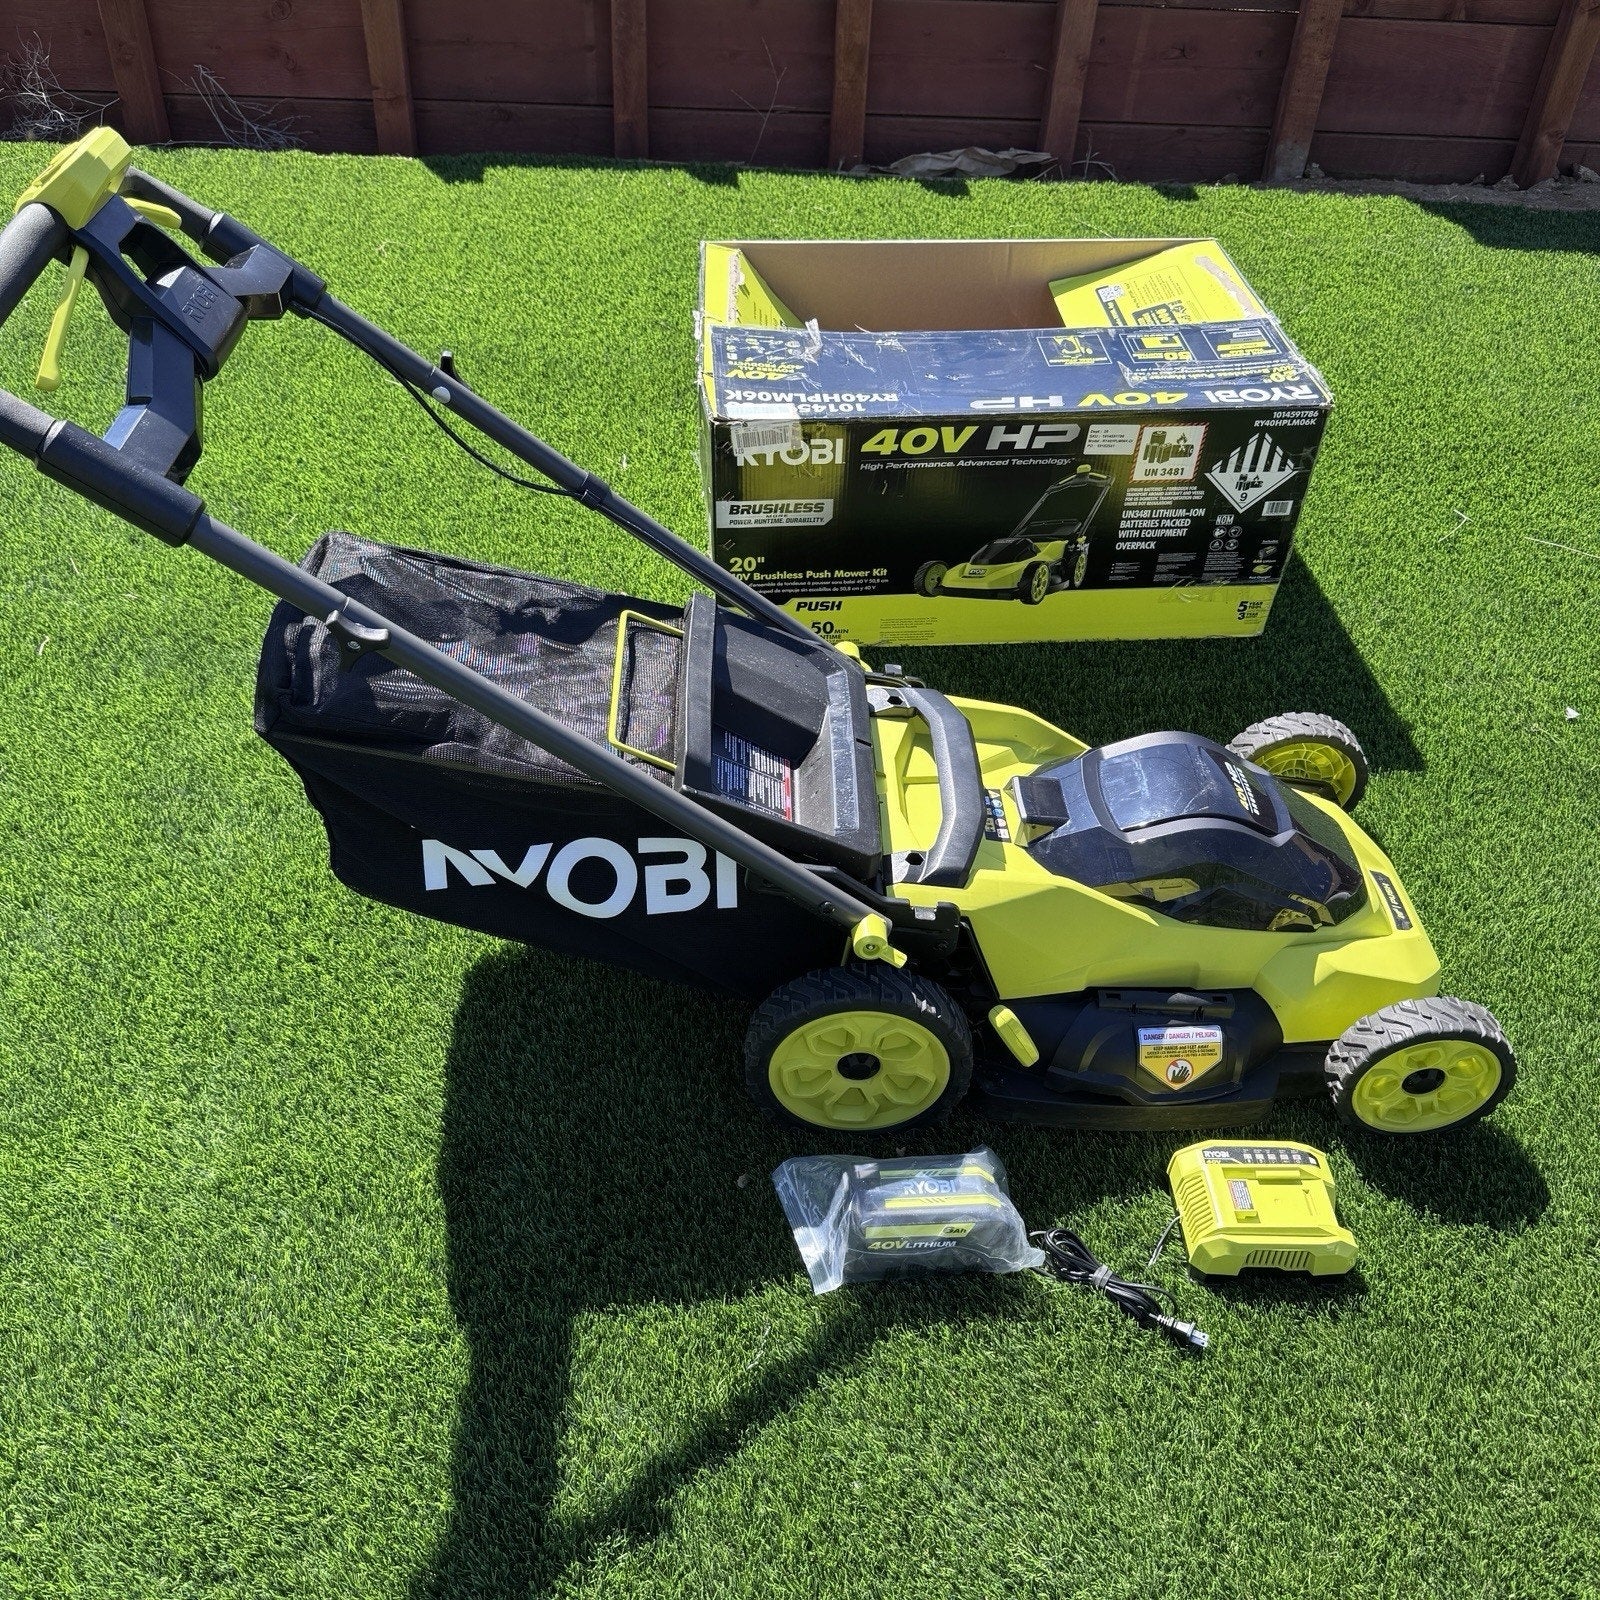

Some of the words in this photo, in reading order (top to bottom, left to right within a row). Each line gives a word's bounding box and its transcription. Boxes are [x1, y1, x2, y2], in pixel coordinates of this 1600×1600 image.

[725, 369, 788, 380] 40V
[724, 389, 899, 403] RY40HPLM06K
[1078, 391, 1188, 407] 40V
[1201, 385, 1318, 403] RYOBI
[969, 396, 1065, 409] HP
[1273, 410, 1319, 419] 1014591786
[1254, 419, 1317, 427] RY40HPLM06K
[860, 426, 980, 455] 40V
[985, 423, 1082, 450] HP
[860, 463, 884, 472] High
[957, 459, 1009, 467] Advanced
[1144, 468, 1159, 477] UN
[1160, 467, 1184, 476] 3481
[1239, 492, 1248, 501] 9
[728, 502, 826, 515] BRUSHLESS
[1121, 509, 1151, 519] UN3481
[1119, 519, 1159, 529] BATTERIES
[1160, 518, 1192, 527] PACKED
[1118, 529, 1140, 538] WITH
[1140, 528, 1188, 538] EQUIPMENT
[1115, 541, 1157, 550] OVERPACK
[729, 556, 765, 572] 20"
[753, 570, 803, 581] Brushless
[806, 569, 831, 579] Push
[834, 569, 869, 578] Mower
[872, 567, 888, 577] Kit
[795, 600, 843, 612] PUSH
[1237, 600, 1249, 612] 5
[1237, 612, 1245, 620] 3
[811, 620, 834, 634] 50
[1203, 1150, 1230, 1158] RYOBI
[903, 1180, 957, 1195] RYOBI
[867, 1239, 908, 1250] 40V
[904, 1240, 957, 1249] LITHIUM
